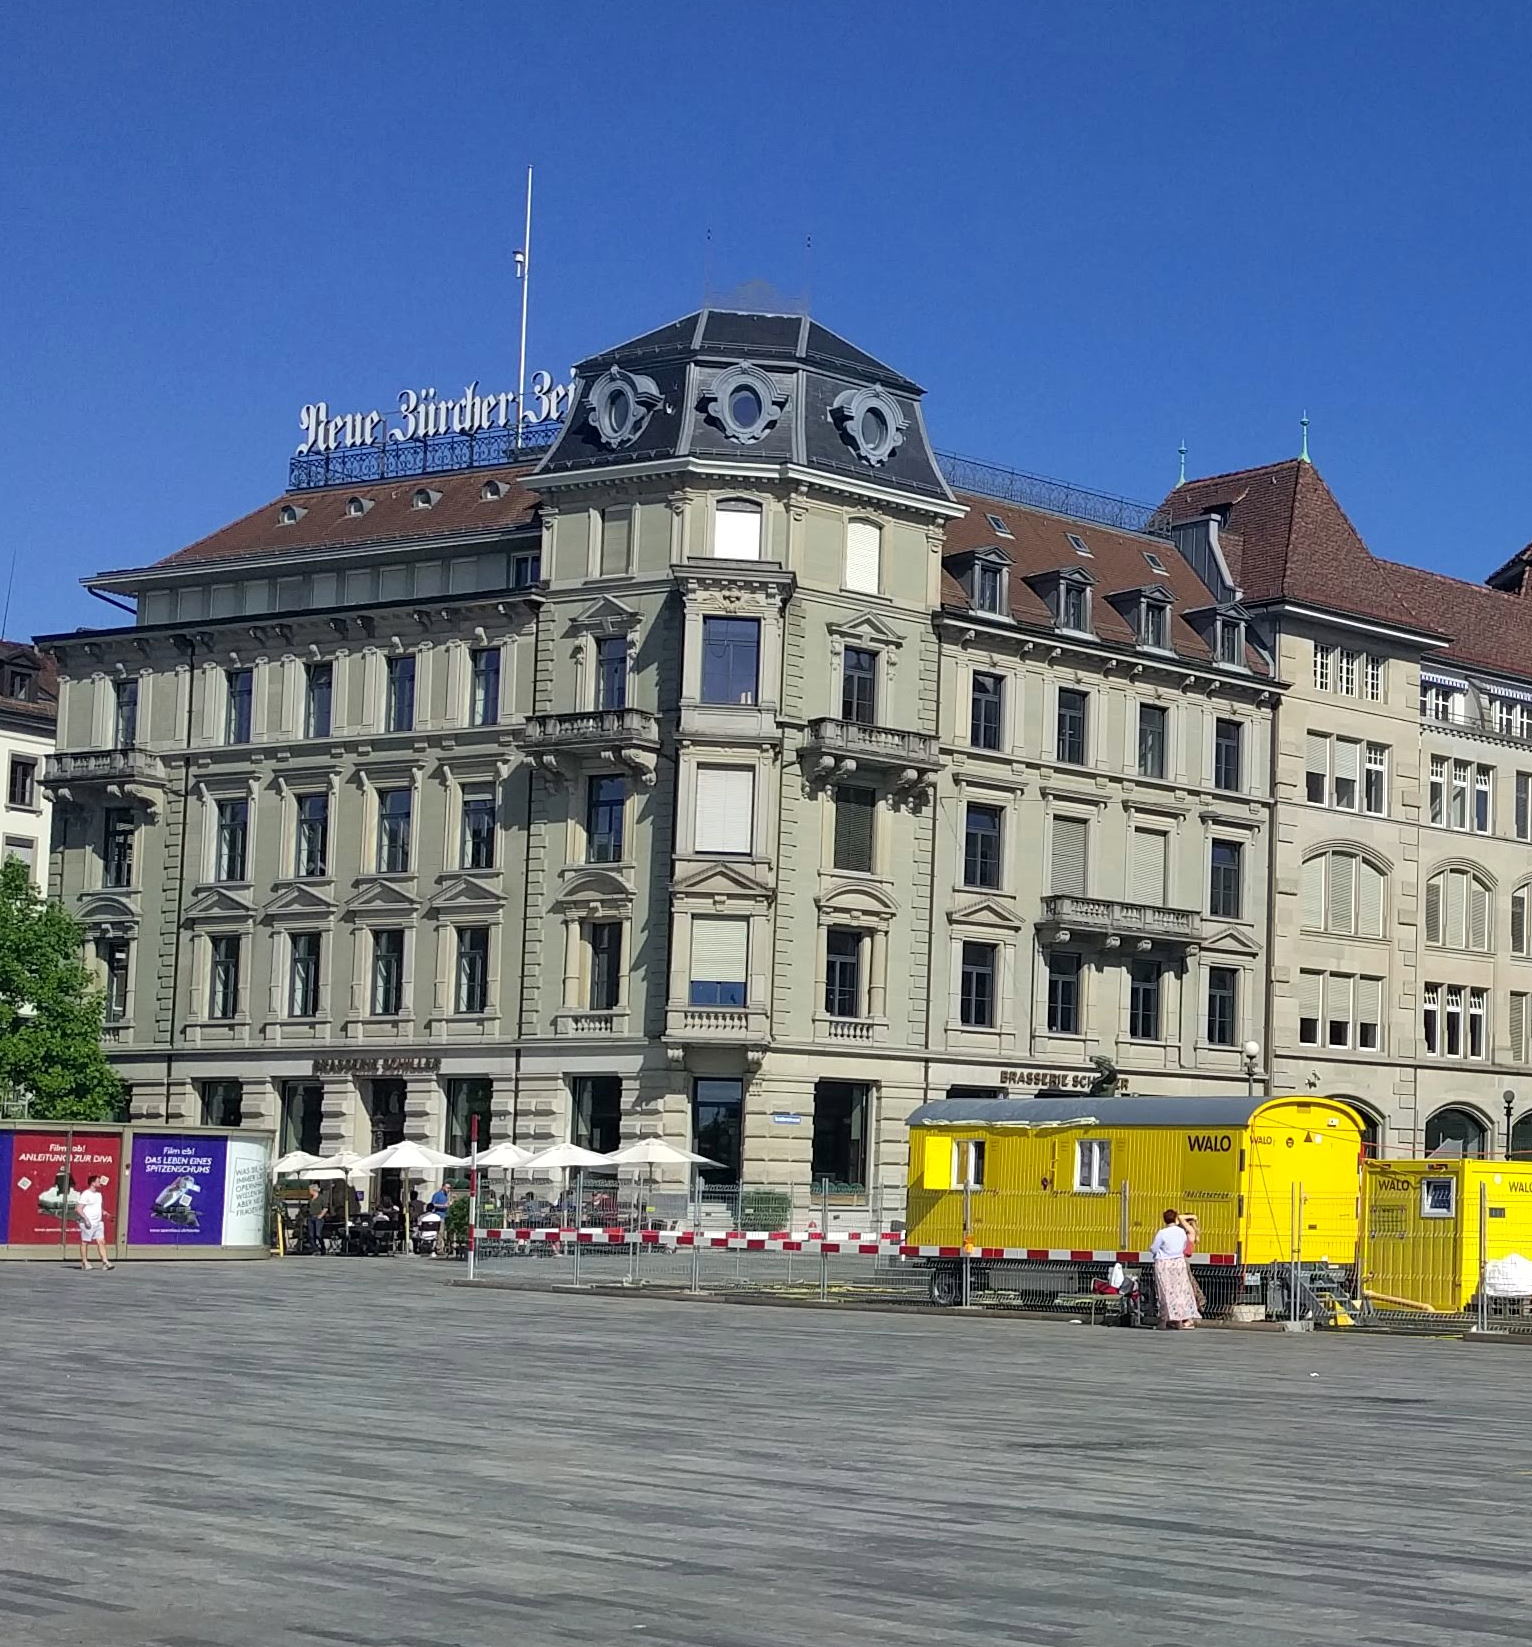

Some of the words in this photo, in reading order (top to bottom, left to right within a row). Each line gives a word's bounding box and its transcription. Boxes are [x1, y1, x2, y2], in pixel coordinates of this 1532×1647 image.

[296, 401, 382, 456] Neue
[387, 380, 516, 442] Zürcher
[1000, 1070, 1069, 1087] BRASSERIE
[1187, 1135, 1232, 1152] WALO
[1250, 1136, 1273, 1145] WALO
[163, 1146, 181, 1155] Film
[73, 1154, 92, 1163] ZUR
[93, 1155, 113, 1163] DIVA
[144, 1156, 162, 1164] DAS
[1378, 1179, 1410, 1192] WALO
